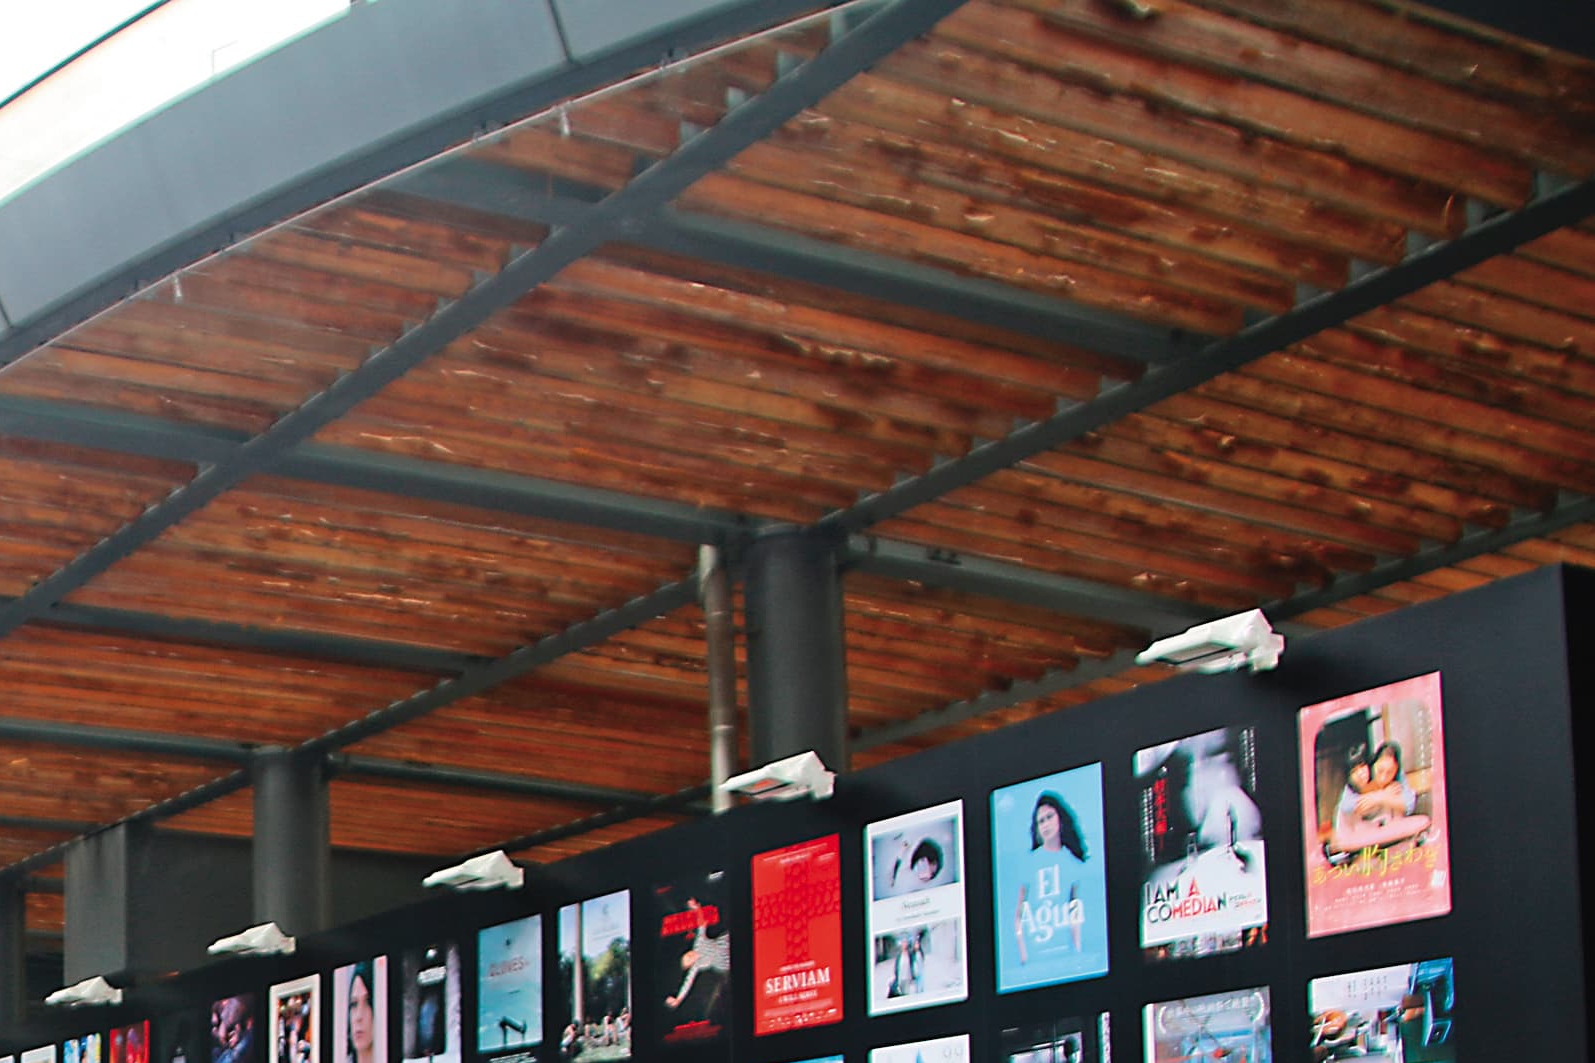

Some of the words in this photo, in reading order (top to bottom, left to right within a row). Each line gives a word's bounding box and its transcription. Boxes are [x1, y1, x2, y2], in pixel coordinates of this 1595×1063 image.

[1037, 863, 1062, 899] El
[1154, 879, 1180, 904] AM
[1188, 876, 1201, 897] A
[1019, 898, 1086, 943] Agua
[1146, 892, 1228, 924] COMEDIAN
[765, 966, 831, 995] SERVIAM
